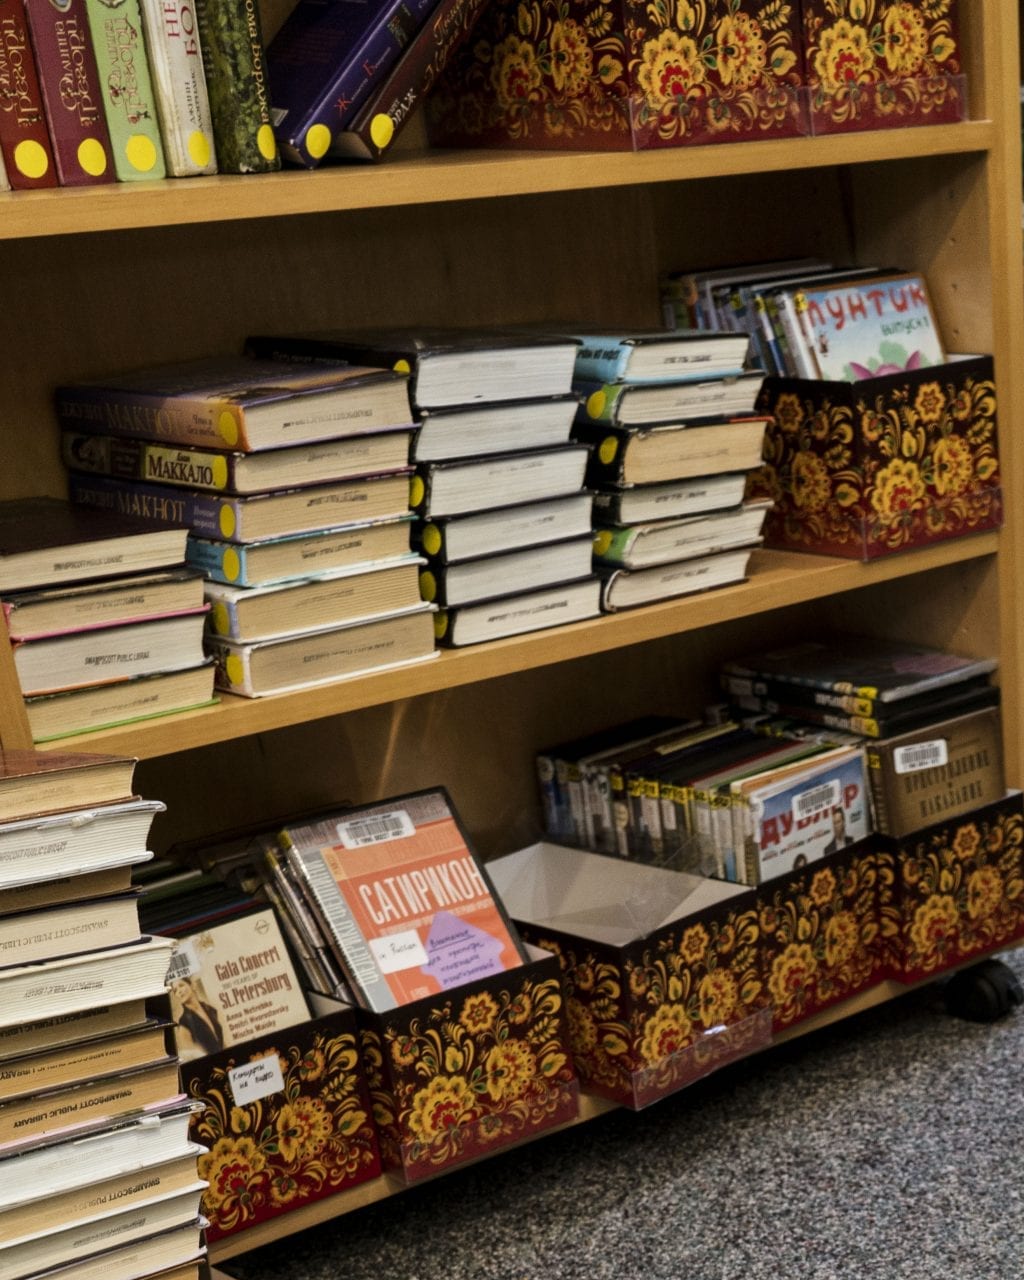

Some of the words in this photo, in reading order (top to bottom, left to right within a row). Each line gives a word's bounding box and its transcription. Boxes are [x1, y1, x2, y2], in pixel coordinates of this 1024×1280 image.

[163, 0, 181, 38] НЕ
[244, 0, 258, 39] ома
[56, 20, 77, 112] Филиппа
[148, 457, 218, 487] МАККАЛО
[358, 855, 490, 925] САТИРИКОН
[214, 960, 240, 982] Gala
[238, 945, 281, 974] Concert
[226, 1010, 243, 1022] Anna
[49, 1103, 78, 1119] PUBLIC
[79, 1088, 133, 1108] SWAMPSCOTT
[13, 1113, 48, 1129] LIBRARY
[107, 1177, 161, 1203] SWAMPSCOTT
